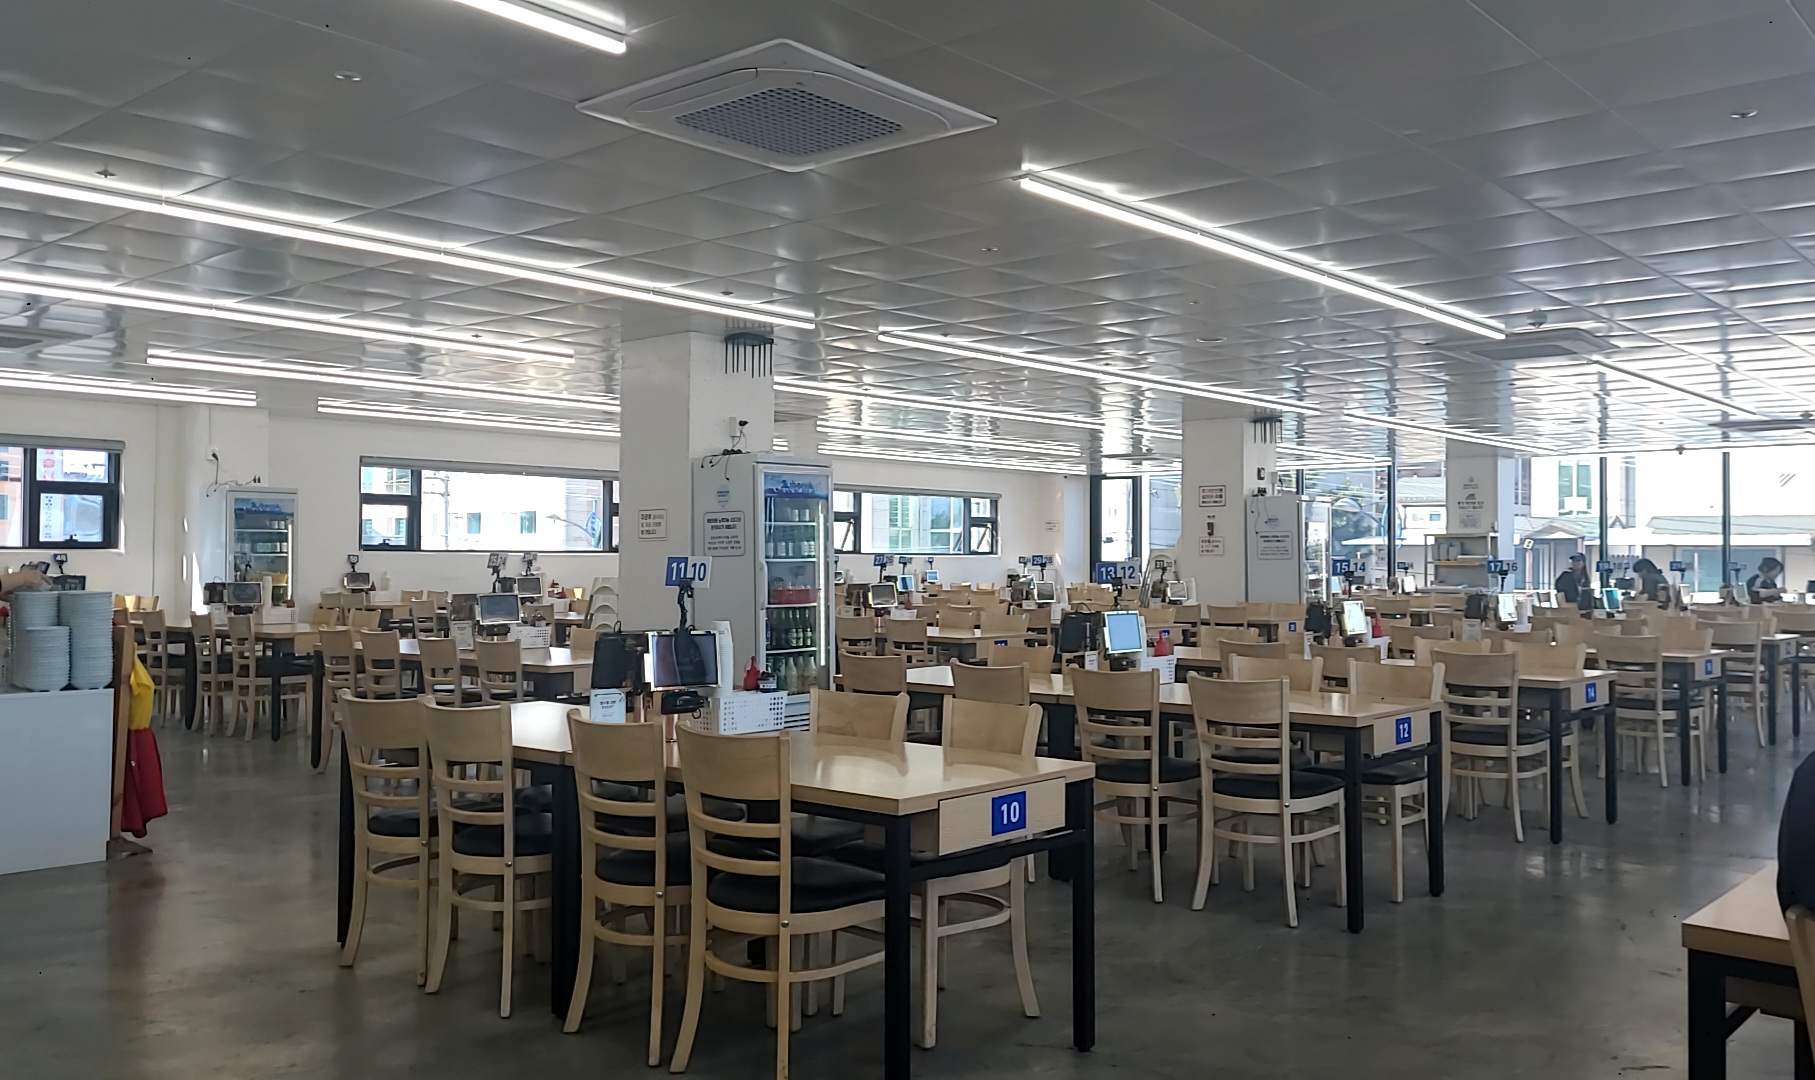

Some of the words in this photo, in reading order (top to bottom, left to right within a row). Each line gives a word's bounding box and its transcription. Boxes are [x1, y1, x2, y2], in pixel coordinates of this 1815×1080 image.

[875, 556, 883, 564] 27
[885, 556, 893, 564] 26
[1335, 562, 1349, 573] 15
[1353, 561, 1366, 573] 14
[1489, 562, 1502, 572] 17
[1506, 562, 1518, 572] 16
[671, 562, 686, 581] 11
[691, 562, 707, 582] 10
[1100, 566, 1116, 581] 13
[1120, 565, 1136, 580] 12
[1587, 686, 1595, 699] 14
[1399, 722, 1409, 739] 12
[1001, 801, 1020, 825] 10
